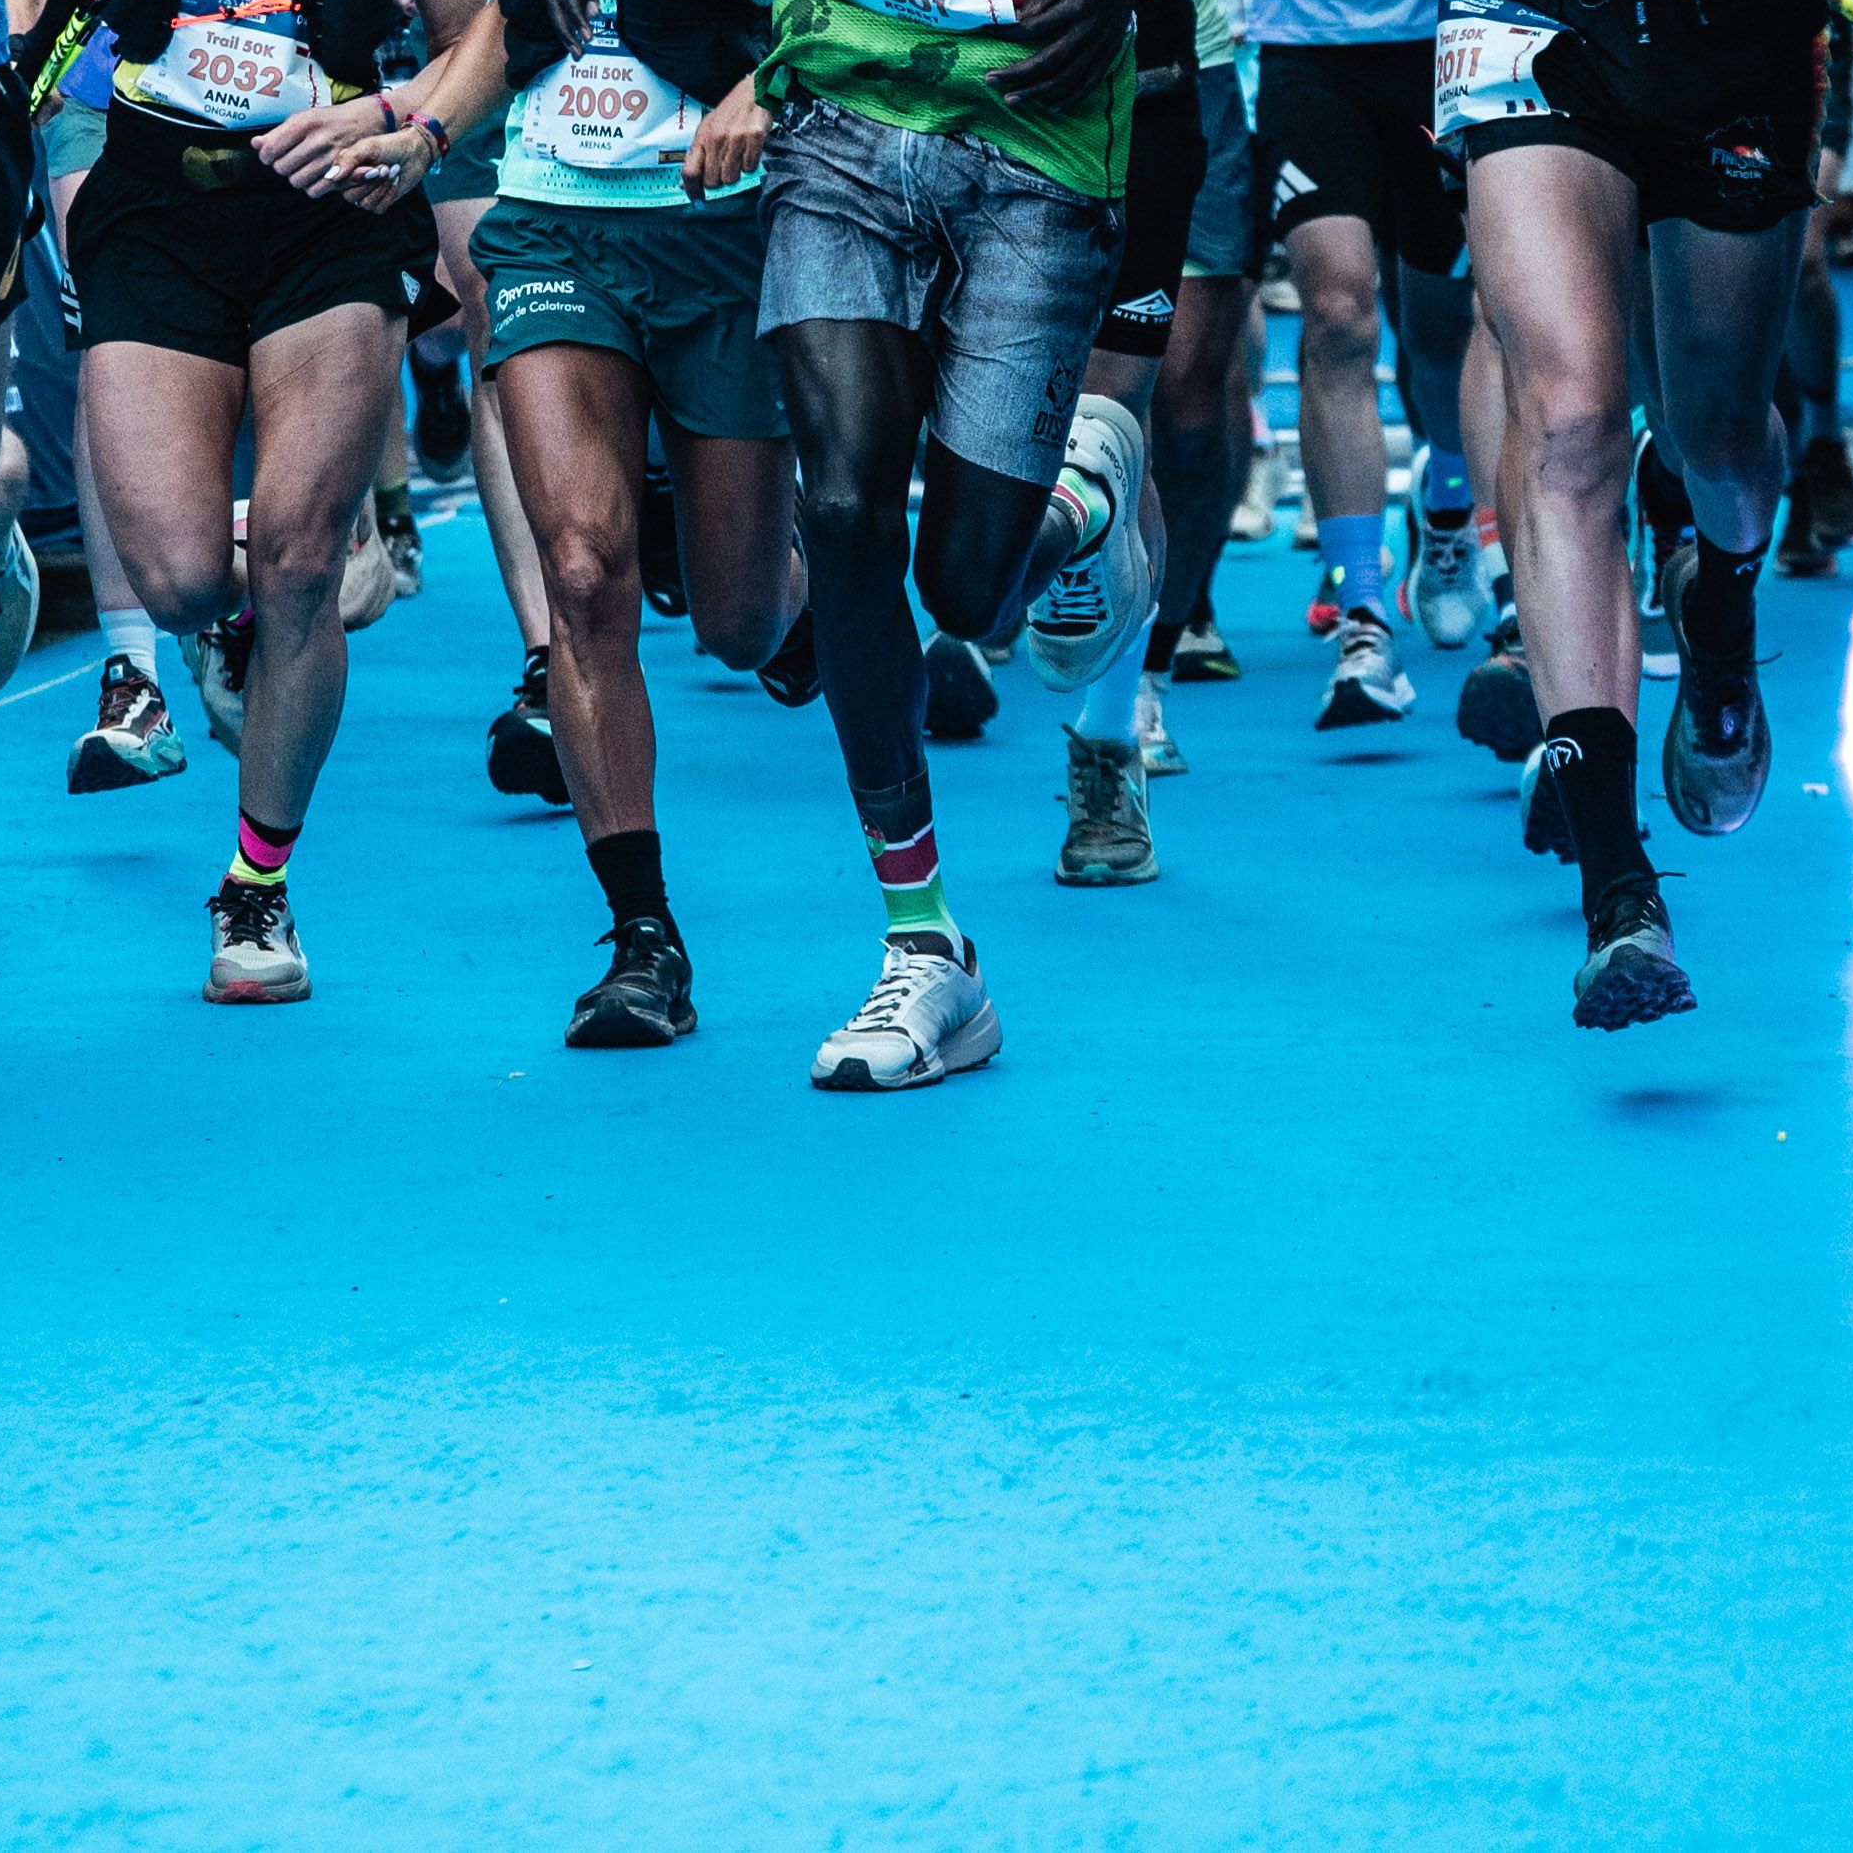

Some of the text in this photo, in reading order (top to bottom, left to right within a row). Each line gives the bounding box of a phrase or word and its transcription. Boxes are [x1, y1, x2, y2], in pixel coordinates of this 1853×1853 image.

[1458, 28, 1487, 42] 50K
[207, 31, 275, 58] Trail 50K
[188, 48, 283, 98] 2032
[570, 64, 634, 82] Trail 50K
[1436, 48, 1482, 89] 2011
[204, 89, 250, 110] ANNA
[558, 84, 649, 121] 2009
[1438, 84, 1470, 107] NATHAN
[204, 104, 246, 121] ONGARO
[572, 123, 624, 139] GEMMA
[579, 140, 612, 151] ARENAS
[515, 306, 526, 317] de
[529, 300, 585, 313] Calatrava
[1112, 309, 1148, 324] NIKE
